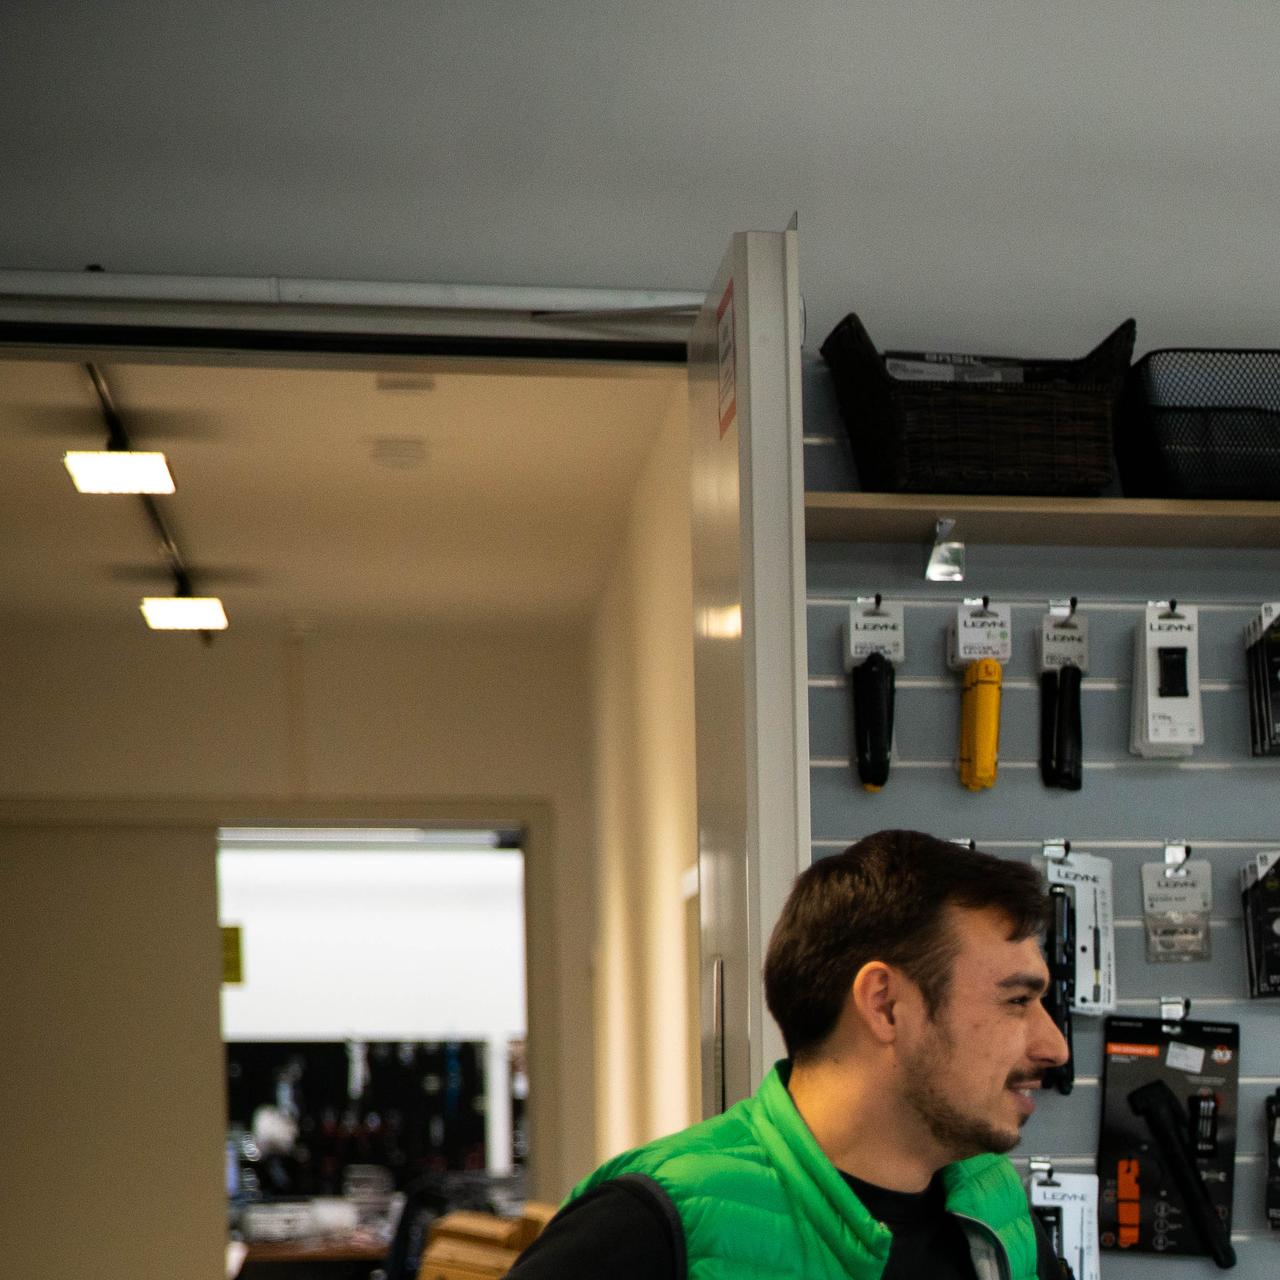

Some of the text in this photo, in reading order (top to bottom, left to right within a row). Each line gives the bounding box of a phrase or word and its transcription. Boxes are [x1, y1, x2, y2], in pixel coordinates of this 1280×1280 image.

[855, 622, 899, 632] LEZYNE
[963, 619, 1008, 630] LEZYNE
[1150, 623, 1194, 632] LEZYNE
[1046, 633, 1083, 643] LEZYNE
[1057, 870, 1099, 883] LEZYNE
[1157, 880, 1196, 888] LEZYNE
[1043, 1191, 1088, 1202] LEZYNE
